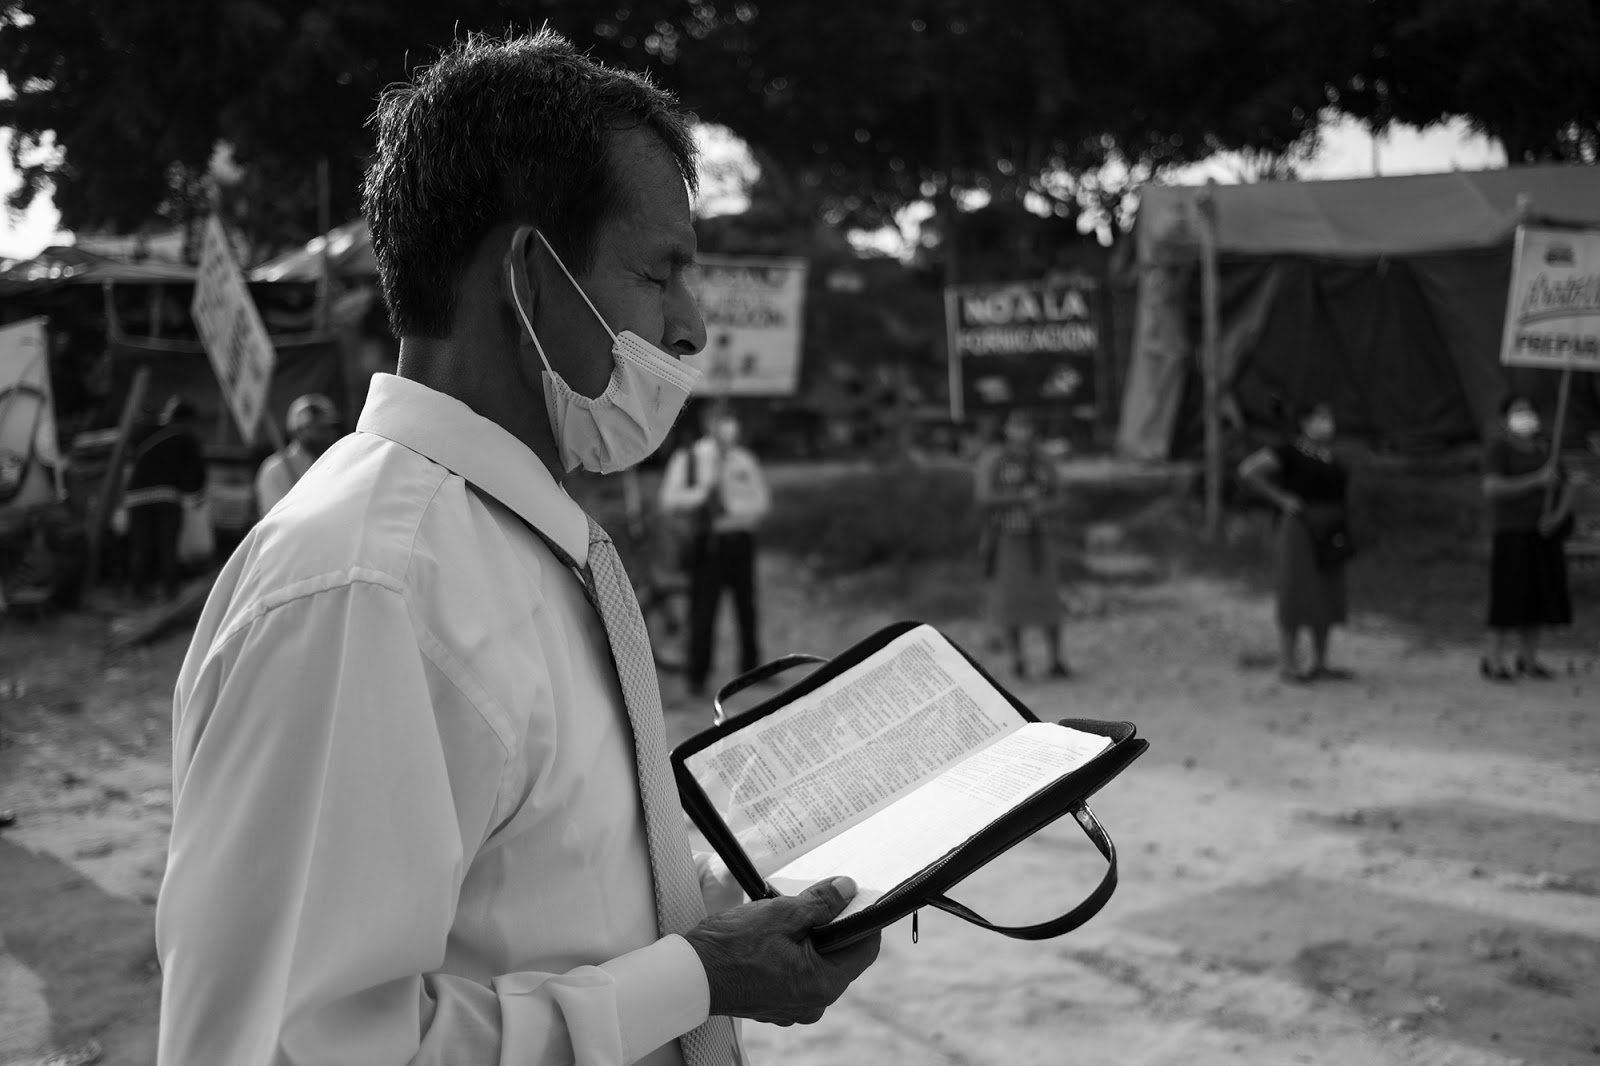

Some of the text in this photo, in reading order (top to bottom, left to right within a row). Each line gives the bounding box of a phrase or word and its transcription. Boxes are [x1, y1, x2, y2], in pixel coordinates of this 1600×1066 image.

[964, 291, 1088, 324] NO A LA
